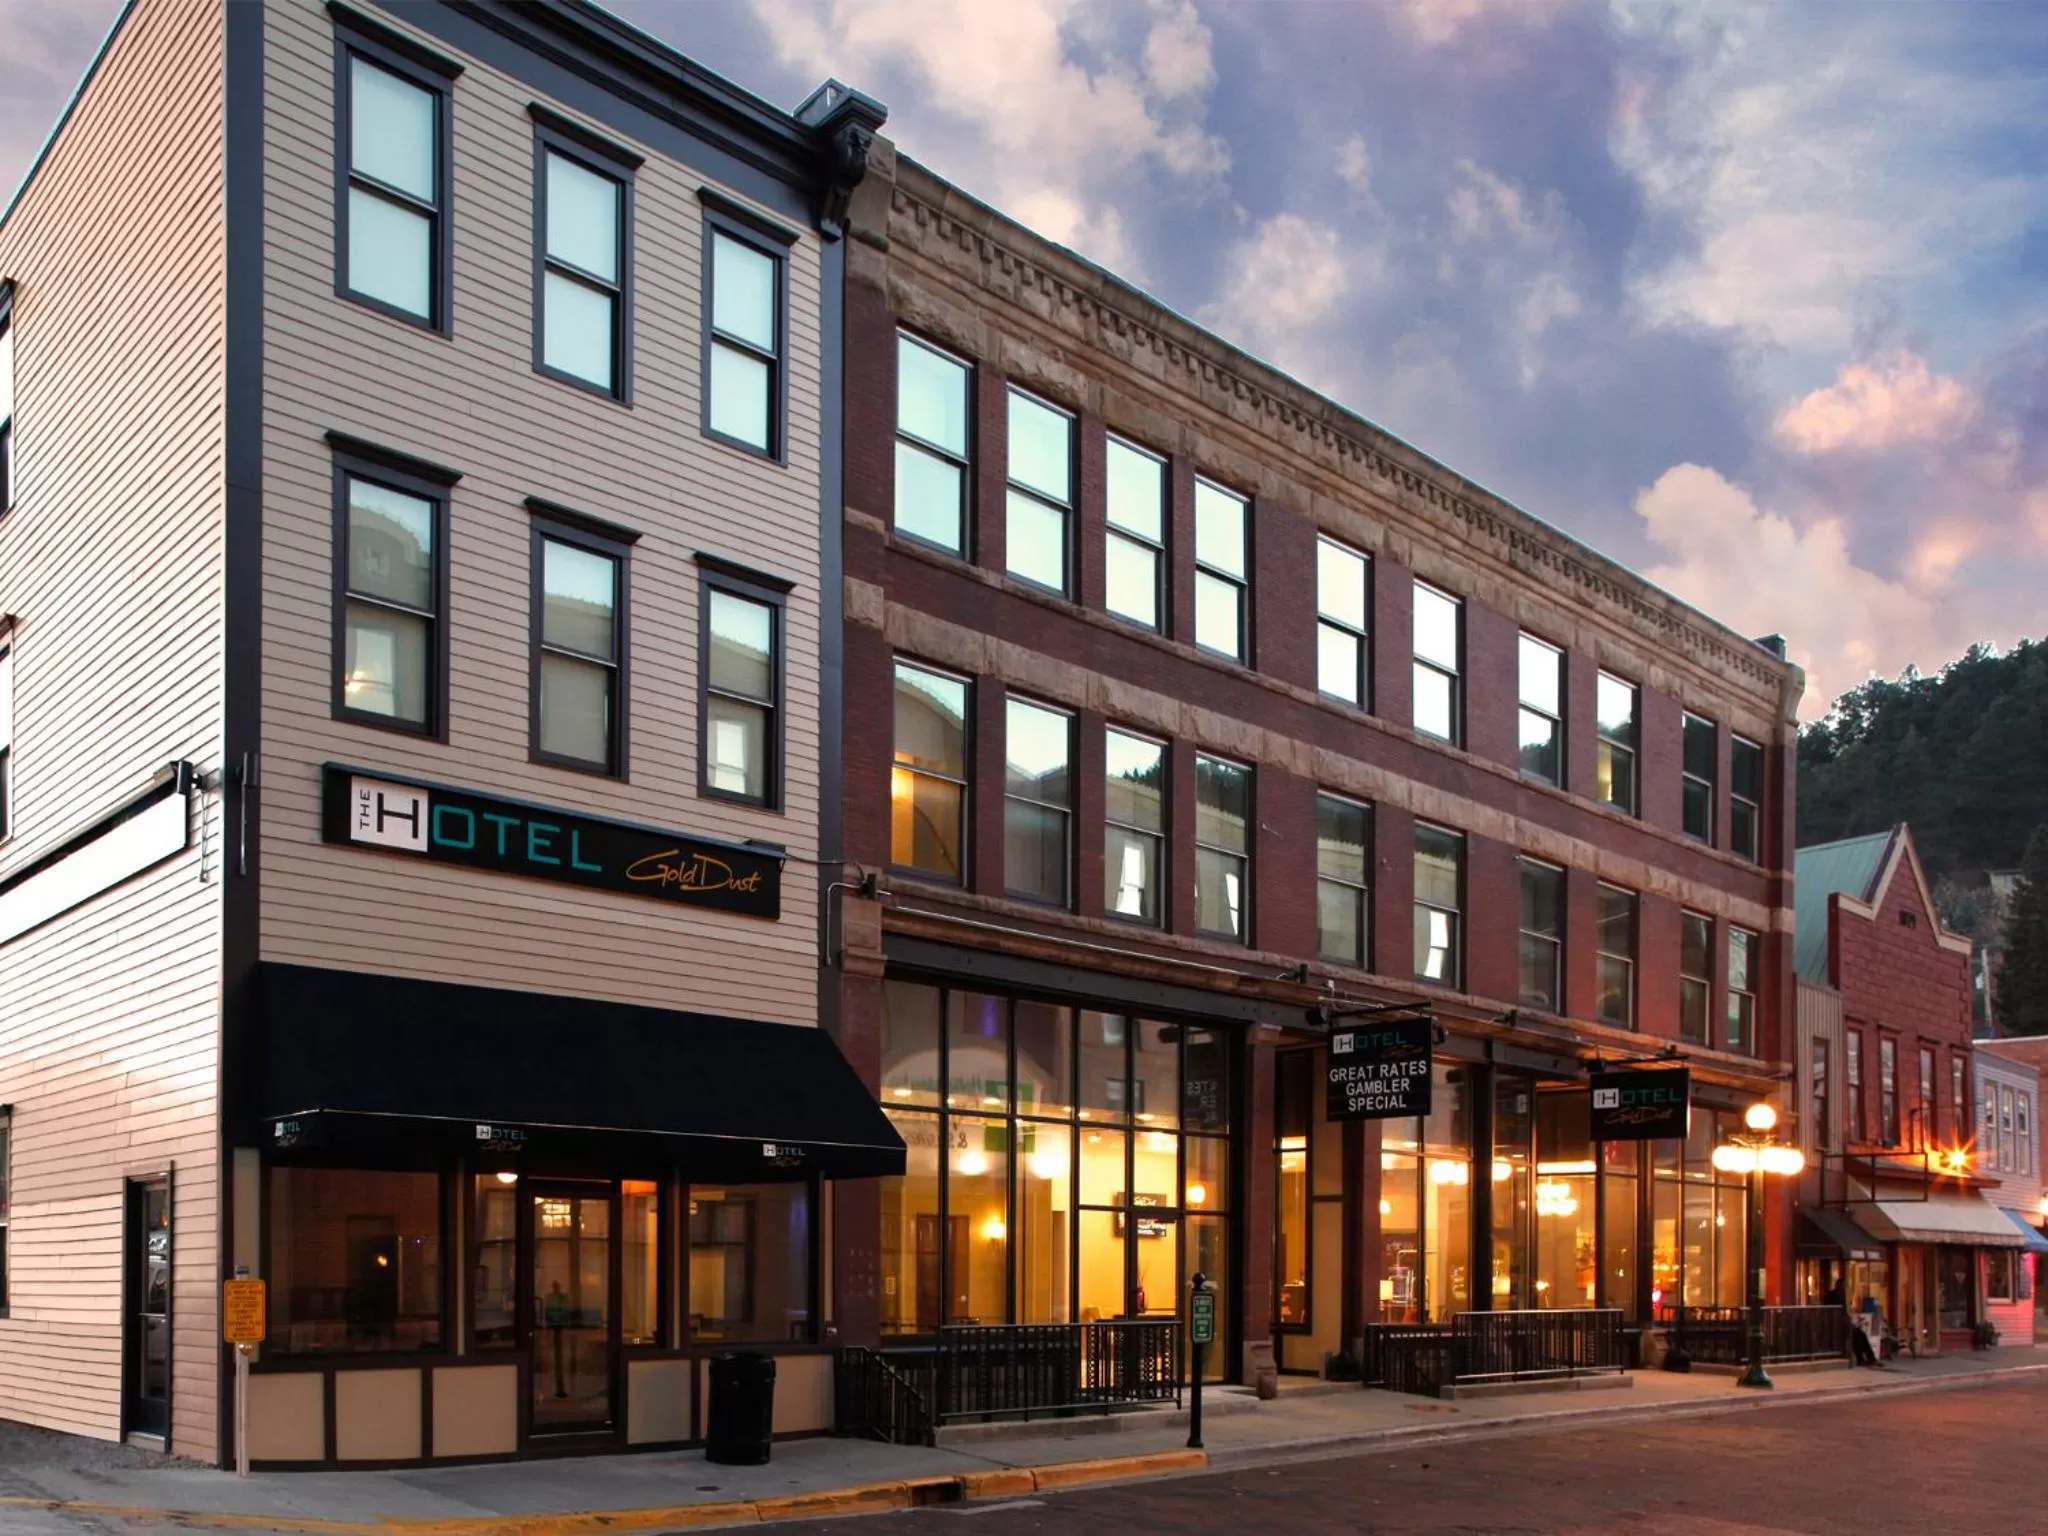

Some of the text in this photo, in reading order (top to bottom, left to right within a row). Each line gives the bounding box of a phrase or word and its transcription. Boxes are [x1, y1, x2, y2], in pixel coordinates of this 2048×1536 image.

[359, 789, 602, 873] THE HOTEL
[1339, 1031, 1407, 1050] HOTEL
[1329, 1060, 1428, 1082] GREAT RATES
[1345, 1077, 1410, 1096] GAMBLER
[1602, 1087, 1683, 1104] HOTEL
[1347, 1095, 1407, 1112] SPECIAL
